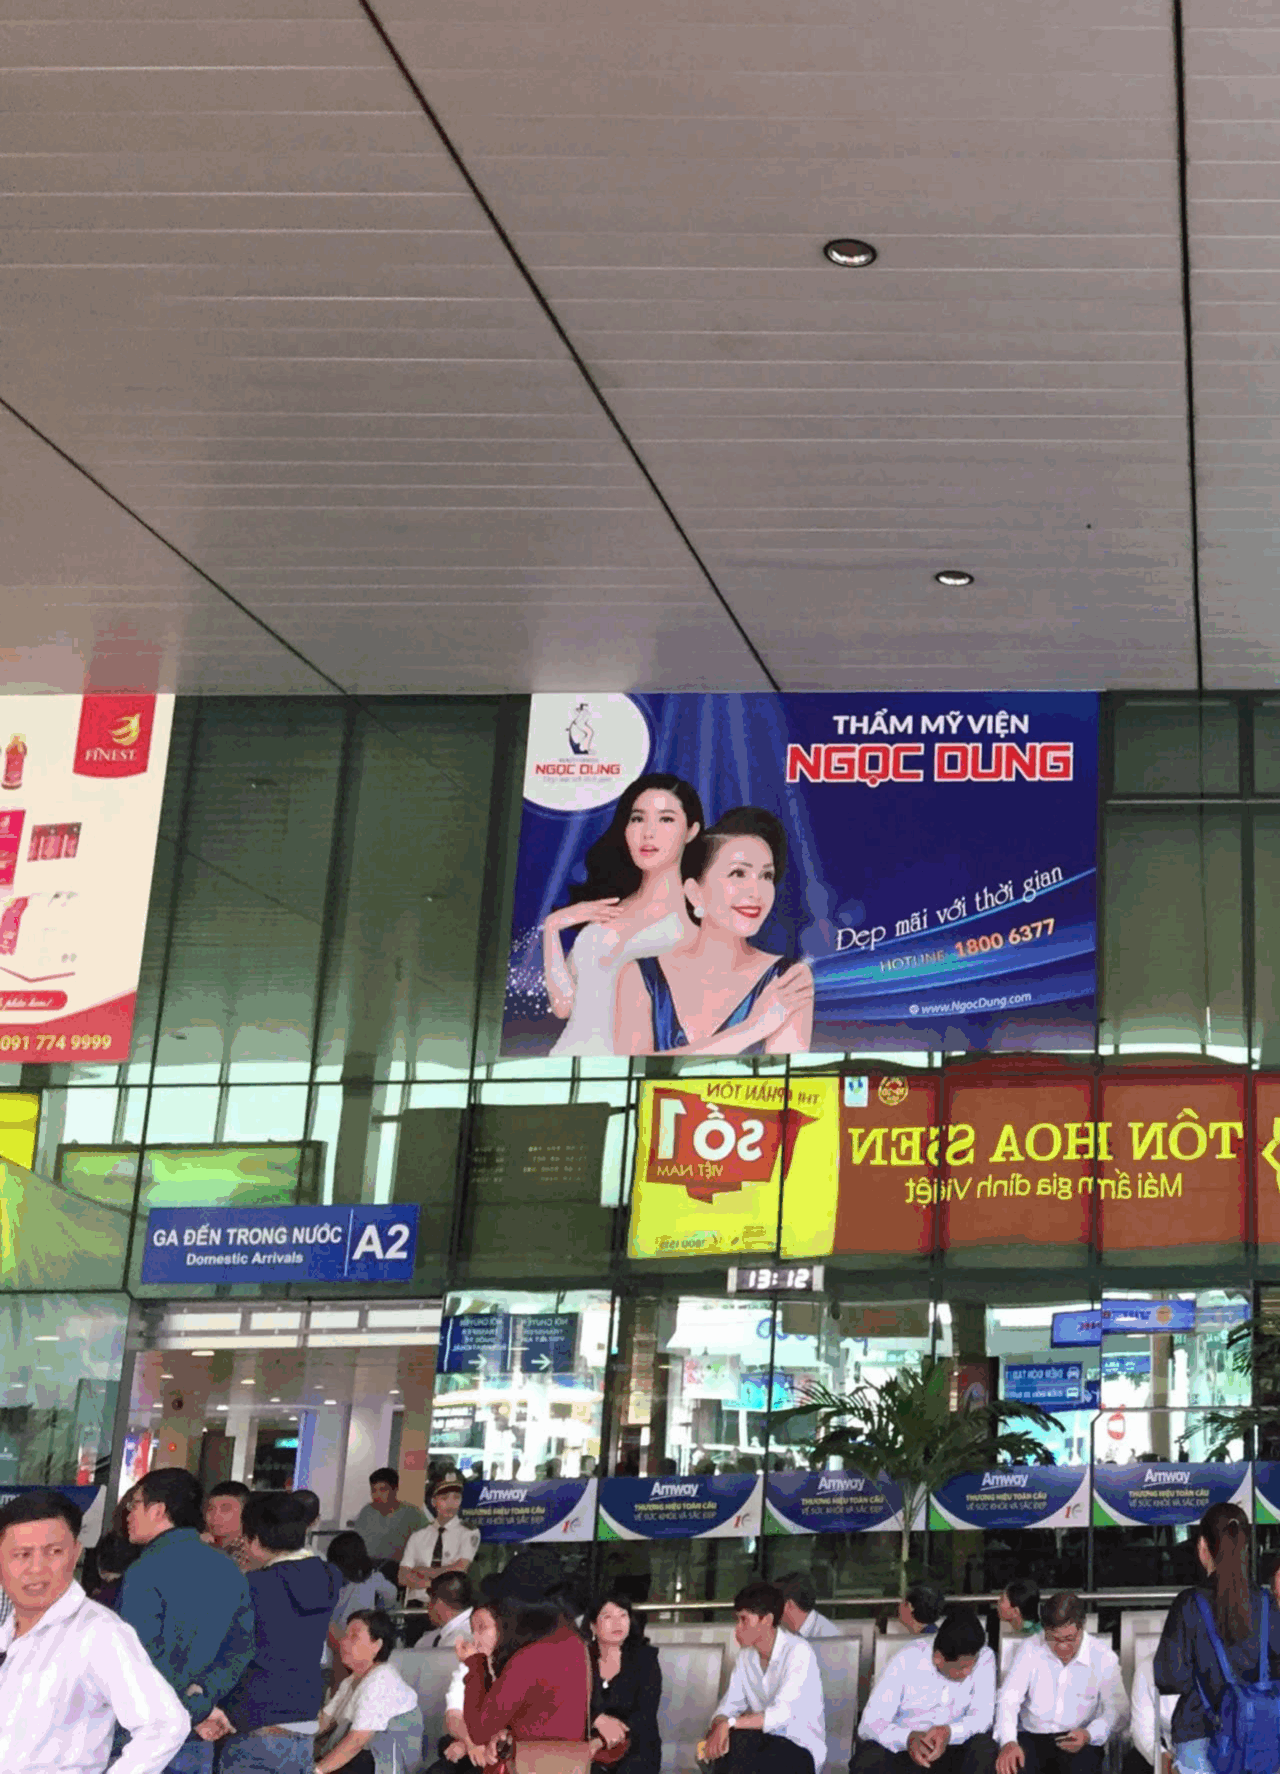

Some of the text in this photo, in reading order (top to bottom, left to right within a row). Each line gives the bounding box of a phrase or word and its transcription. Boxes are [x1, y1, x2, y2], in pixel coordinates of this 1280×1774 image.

[833, 708, 1029, 738] THẨM MỸ VIỆN
[786, 742, 1074, 788] NGỌC DUNG
[895, 908, 928, 937] mãi
[936, 897, 967, 924] với
[975, 880, 1015, 912] thời
[1022, 866, 1064, 904] gian
[879, 917, 1056, 972] HOTLINE 1800 6377
[921, 992, 1032, 1014] www.NgocDung.com
[0, 1034, 112, 1051] 091 774 9999
[153, 1223, 342, 1246] GA ĐẾN TRONG NƯỚC
[352, 1223, 411, 1261] A2
[186, 1251, 304, 1266] Domestic Arrivals
[817, 1476, 865, 1492] Amway
[982, 1472, 1029, 1488] Amway
[1144, 1468, 1191, 1485] Amway
[479, 1486, 528, 1503] Amway
[651, 1481, 699, 1498] Amway
